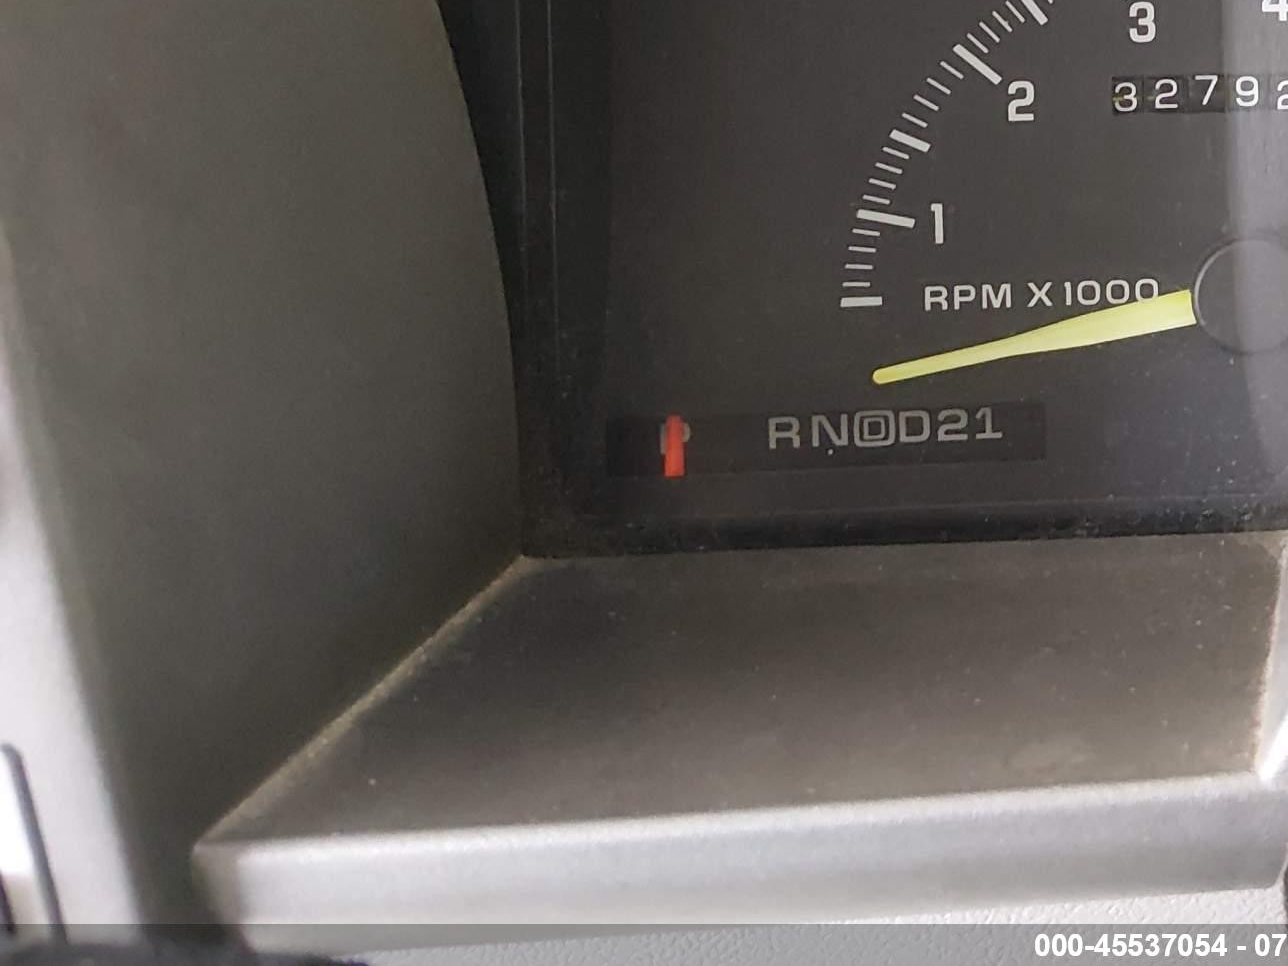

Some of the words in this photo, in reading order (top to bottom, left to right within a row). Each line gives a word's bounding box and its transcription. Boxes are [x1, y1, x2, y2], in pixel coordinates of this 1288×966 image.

[1129, 1, 1157, 43] 3
[1007, 80, 1036, 122] 2
[930, 202, 944, 244] 1
[924, 283, 1013, 311] RPM
[1065, 278, 1160, 307] 1000
